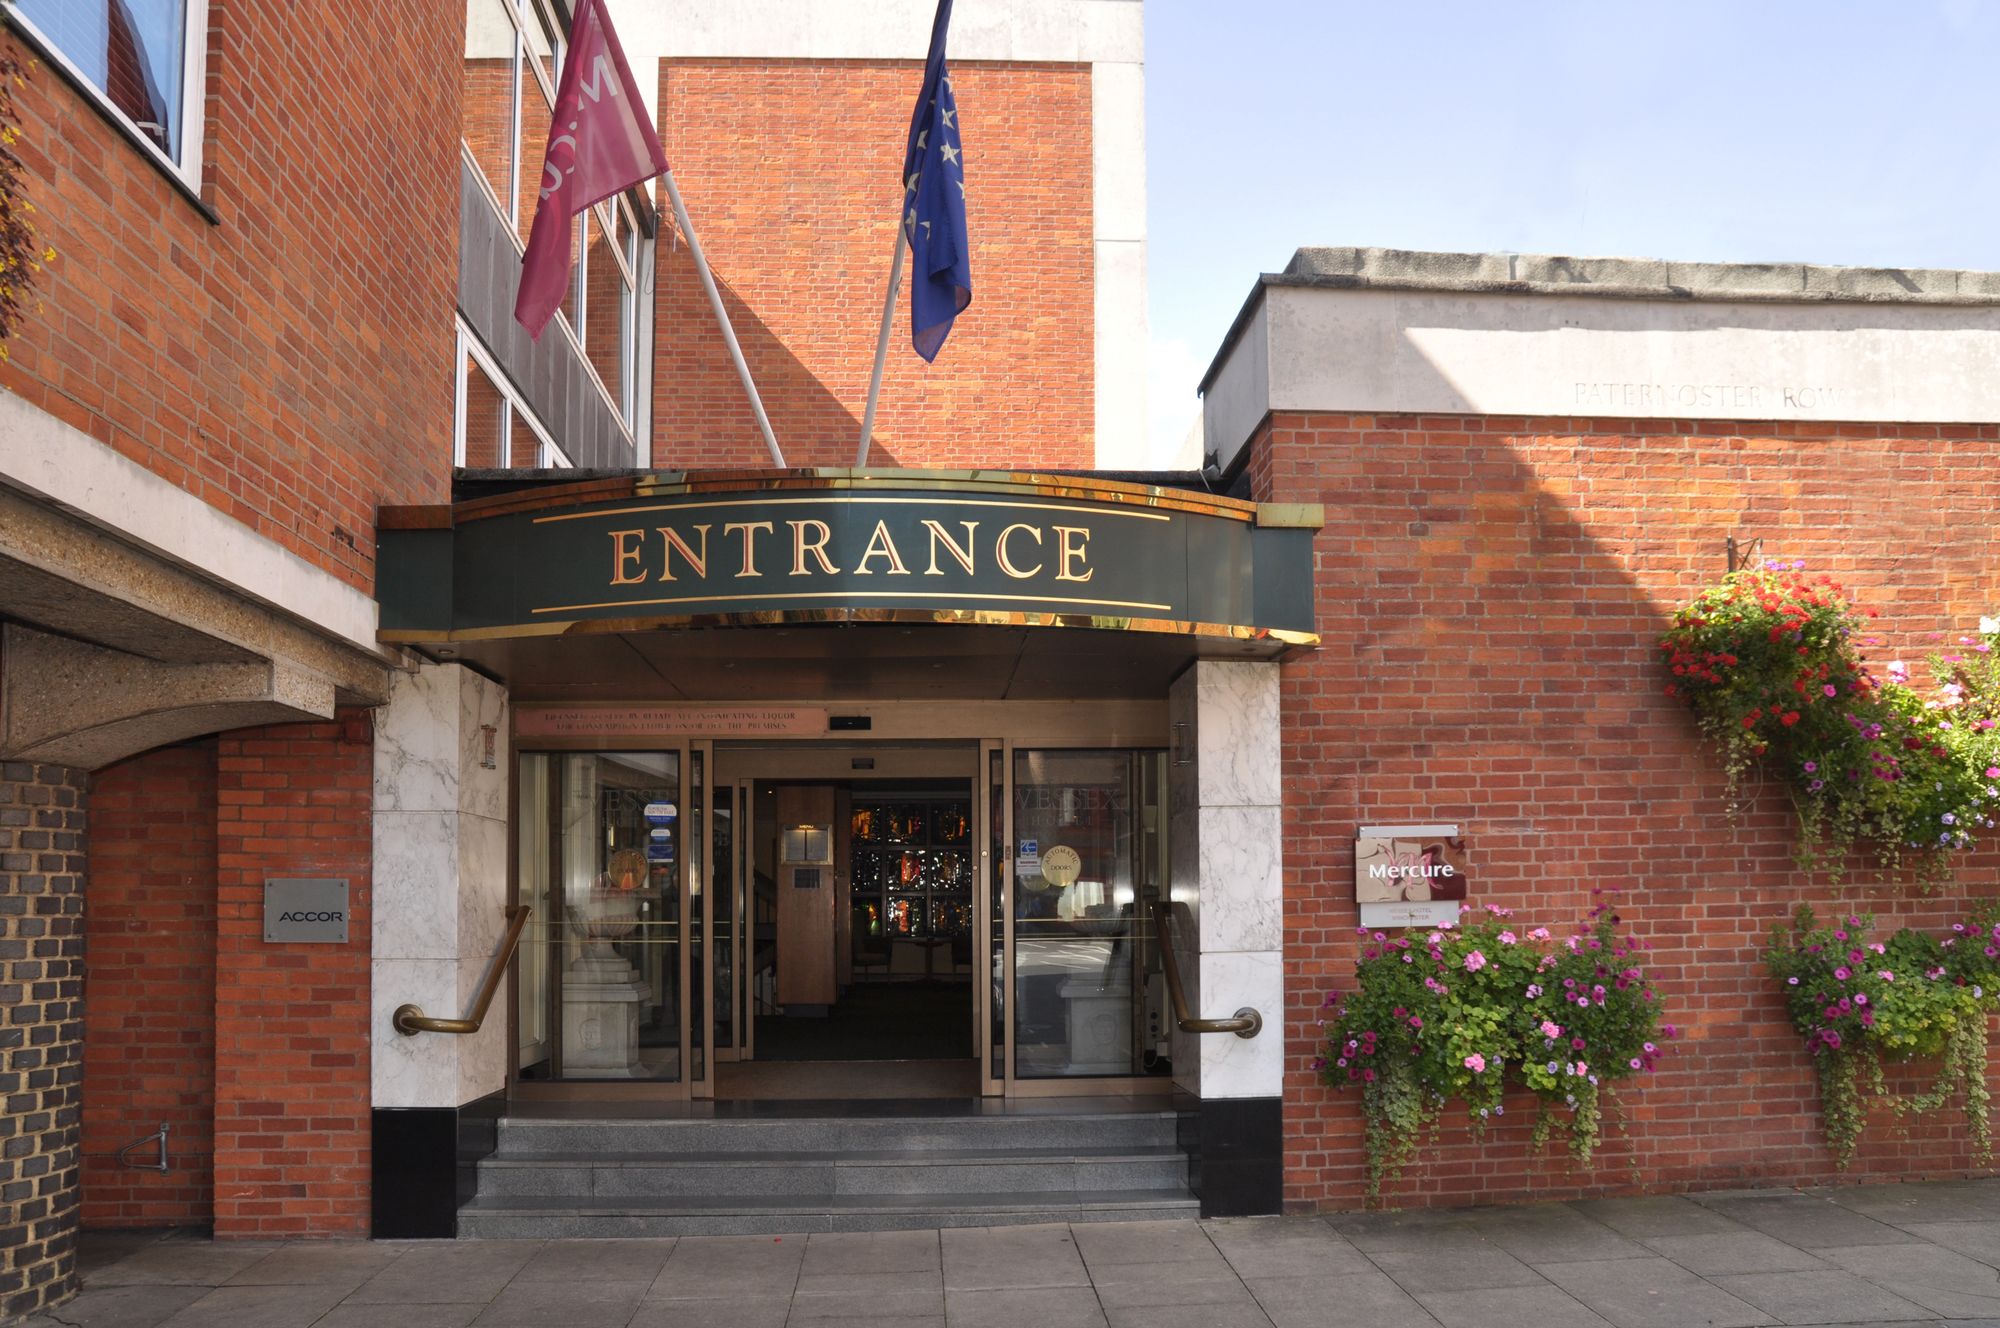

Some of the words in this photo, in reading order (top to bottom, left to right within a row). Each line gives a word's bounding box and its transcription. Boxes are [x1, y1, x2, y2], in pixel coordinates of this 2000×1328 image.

[1575, 383, 1762, 408] PATERNOSTER
[1782, 386, 1844, 409] ROW
[608, 519, 1093, 585] ENTRANCE
[762, 712, 796, 720] LIQUOR
[1045, 848, 1079, 865] AUTOMATIC
[1369, 864, 1454, 878] Mercure
[279, 911, 343, 923] ACCOR
